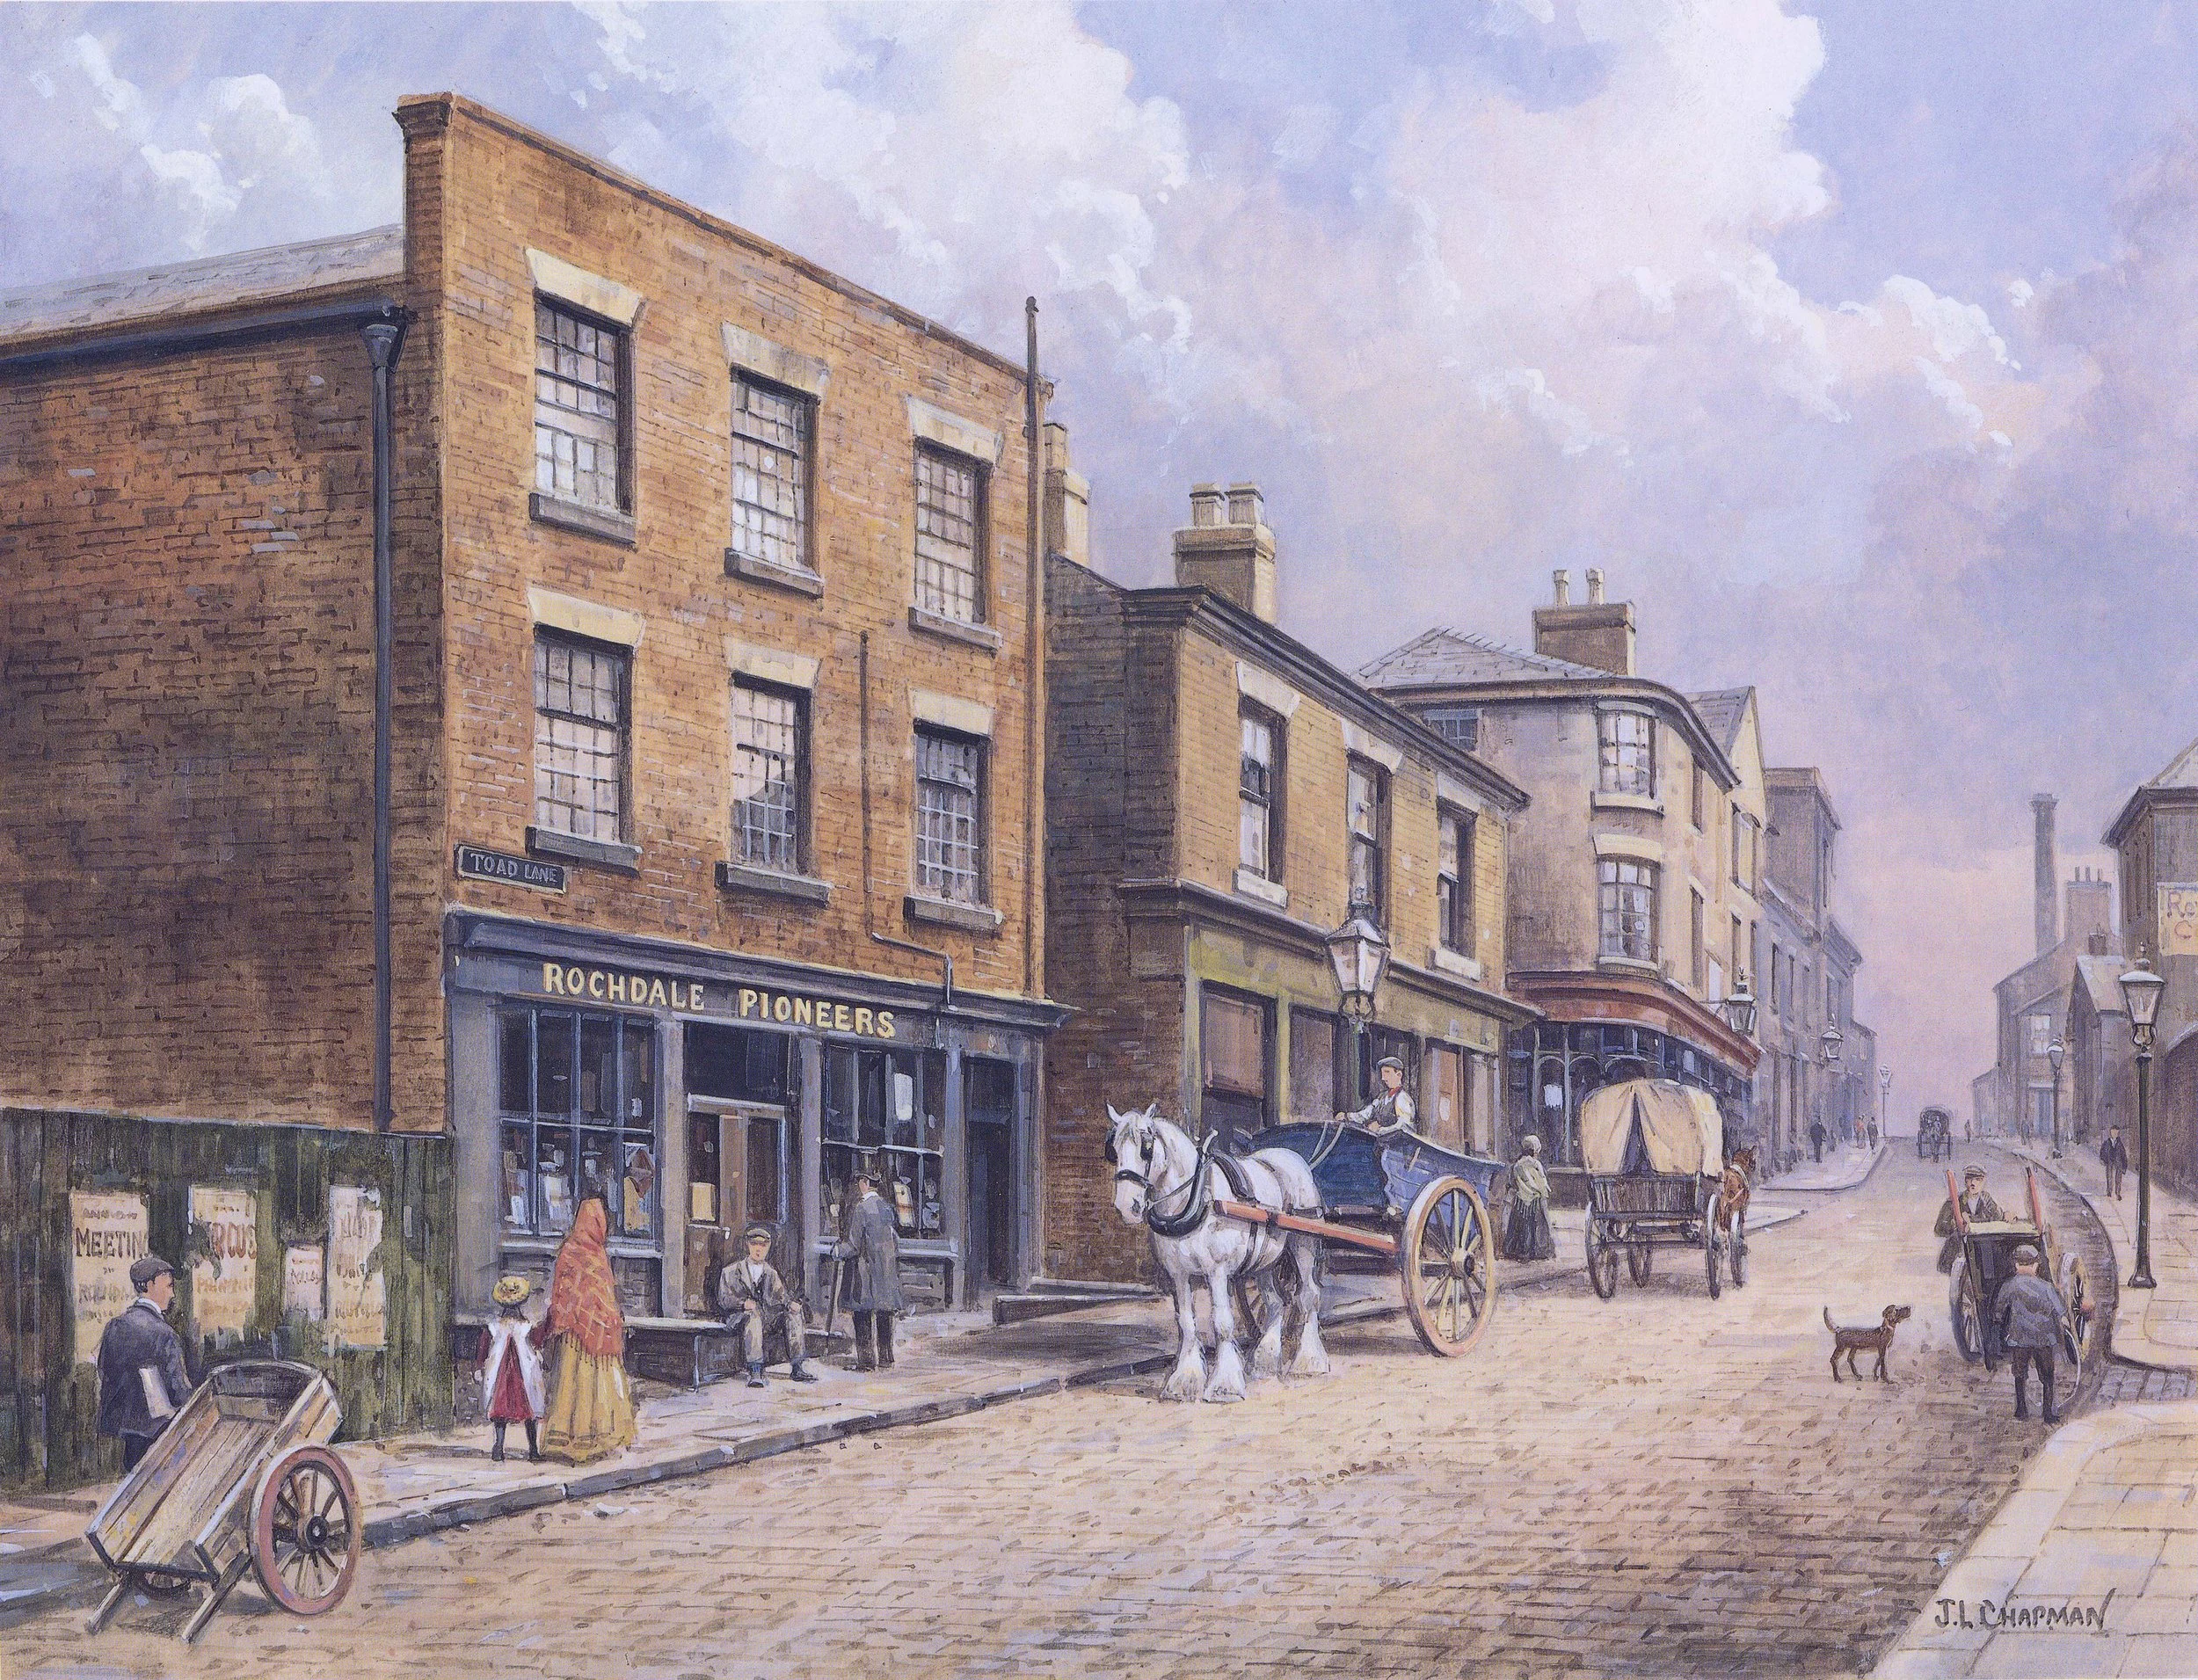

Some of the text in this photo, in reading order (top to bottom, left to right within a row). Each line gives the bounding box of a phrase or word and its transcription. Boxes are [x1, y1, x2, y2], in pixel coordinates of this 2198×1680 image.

[470, 853, 558, 884] TOAD LANE
[542, 963, 896, 1038] ROCHDALE PIONEERS
[1978, 1587, 2117, 1631] CHAPMAN
